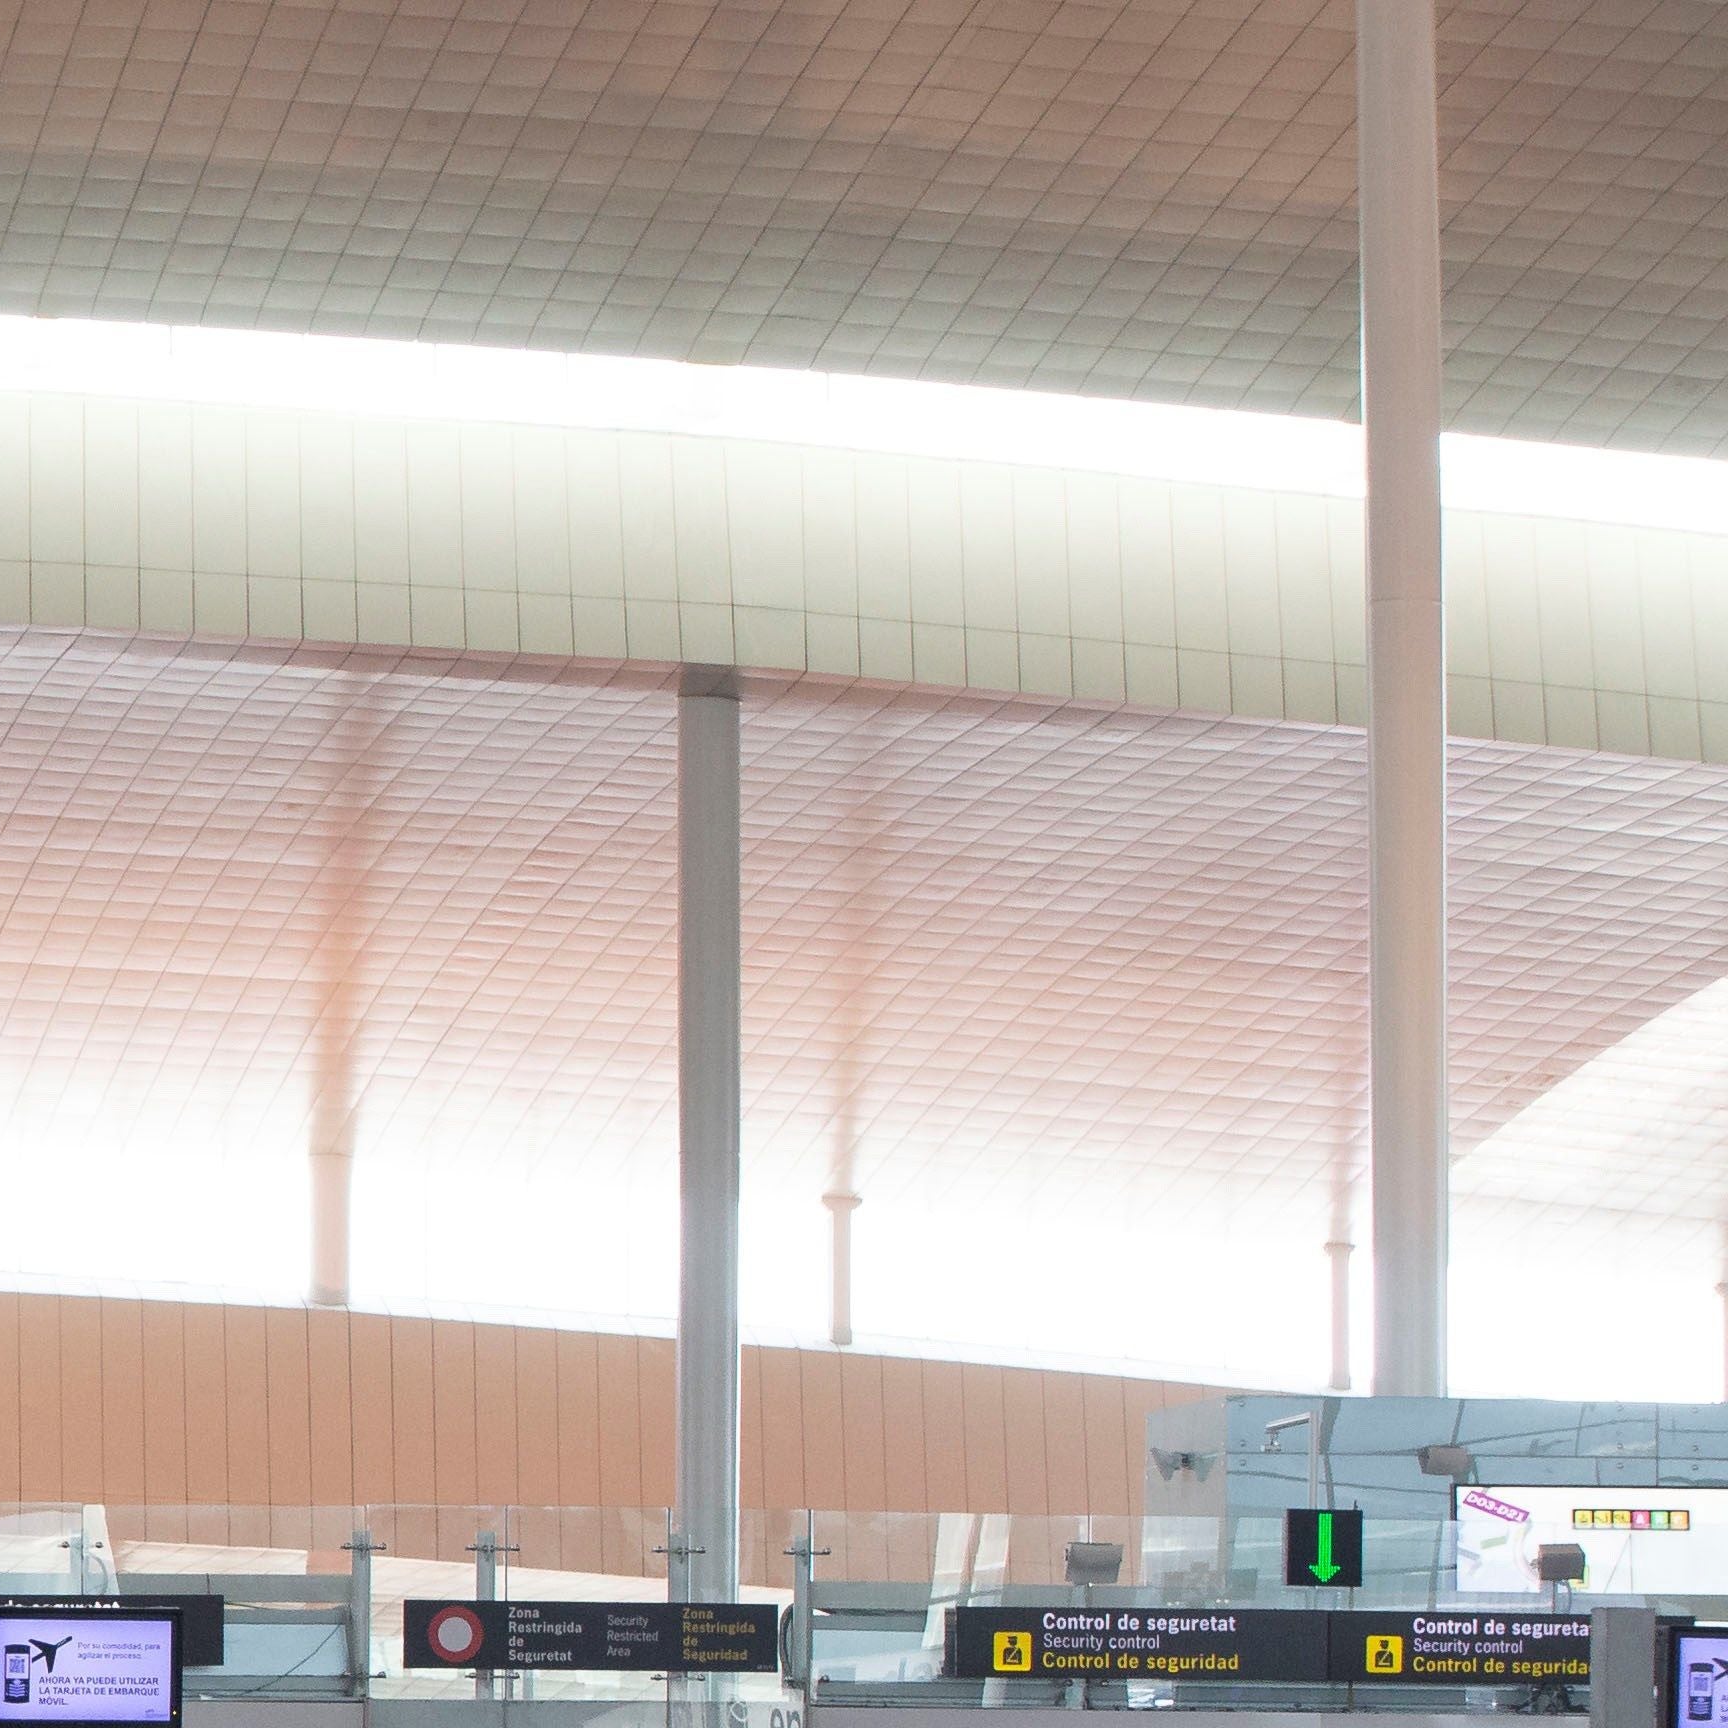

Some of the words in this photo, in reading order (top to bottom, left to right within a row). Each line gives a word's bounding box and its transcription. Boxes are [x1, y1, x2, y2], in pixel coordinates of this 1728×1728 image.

[509, 1607, 539, 1618] Zona
[683, 1608, 713, 1620] Zona
[608, 1615, 648, 1628] Security
[683, 1621, 755, 1635] Restringida
[1043, 1613, 1110, 1630] Control
[1118, 1614, 1139, 1630] de
[1147, 1617, 1235, 1634] seguretat
[1413, 1618, 1478, 1635] Control
[1485, 1618, 1505, 1635] de
[1512, 1622, 1592, 1638] segureta
[509, 1621, 582, 1637] Restringida
[607, 1630, 658, 1641] Restricted
[509, 1636, 524, 1647] de
[683, 1636, 698, 1646] de
[1044, 1633, 1103, 1653] Security
[1109, 1635, 1159, 1649] control
[1413, 1638, 1470, 1655] Security
[1475, 1640, 1523, 1653] control
[509, 1650, 572, 1663] Seguretat
[607, 1645, 630, 1656] Area
[683, 1649, 747, 1662] Seguridad
[1043, 1652, 1109, 1668] Control
[1118, 1653, 1138, 1668] de
[1147, 1654, 1238, 1672] seguridad
[1413, 1657, 1477, 1672] Control
[1484, 1657, 1504, 1672] de
[1512, 1659, 1591, 1676] segurida
[39, 1677, 71, 1685] AHORA
[87, 1677, 117, 1685] PUEDE
[119, 1677, 158, 1685] UTILIZAR
[53, 1687, 91, 1695] TARJETA
[109, 1687, 159, 1695] EMBARQUE
